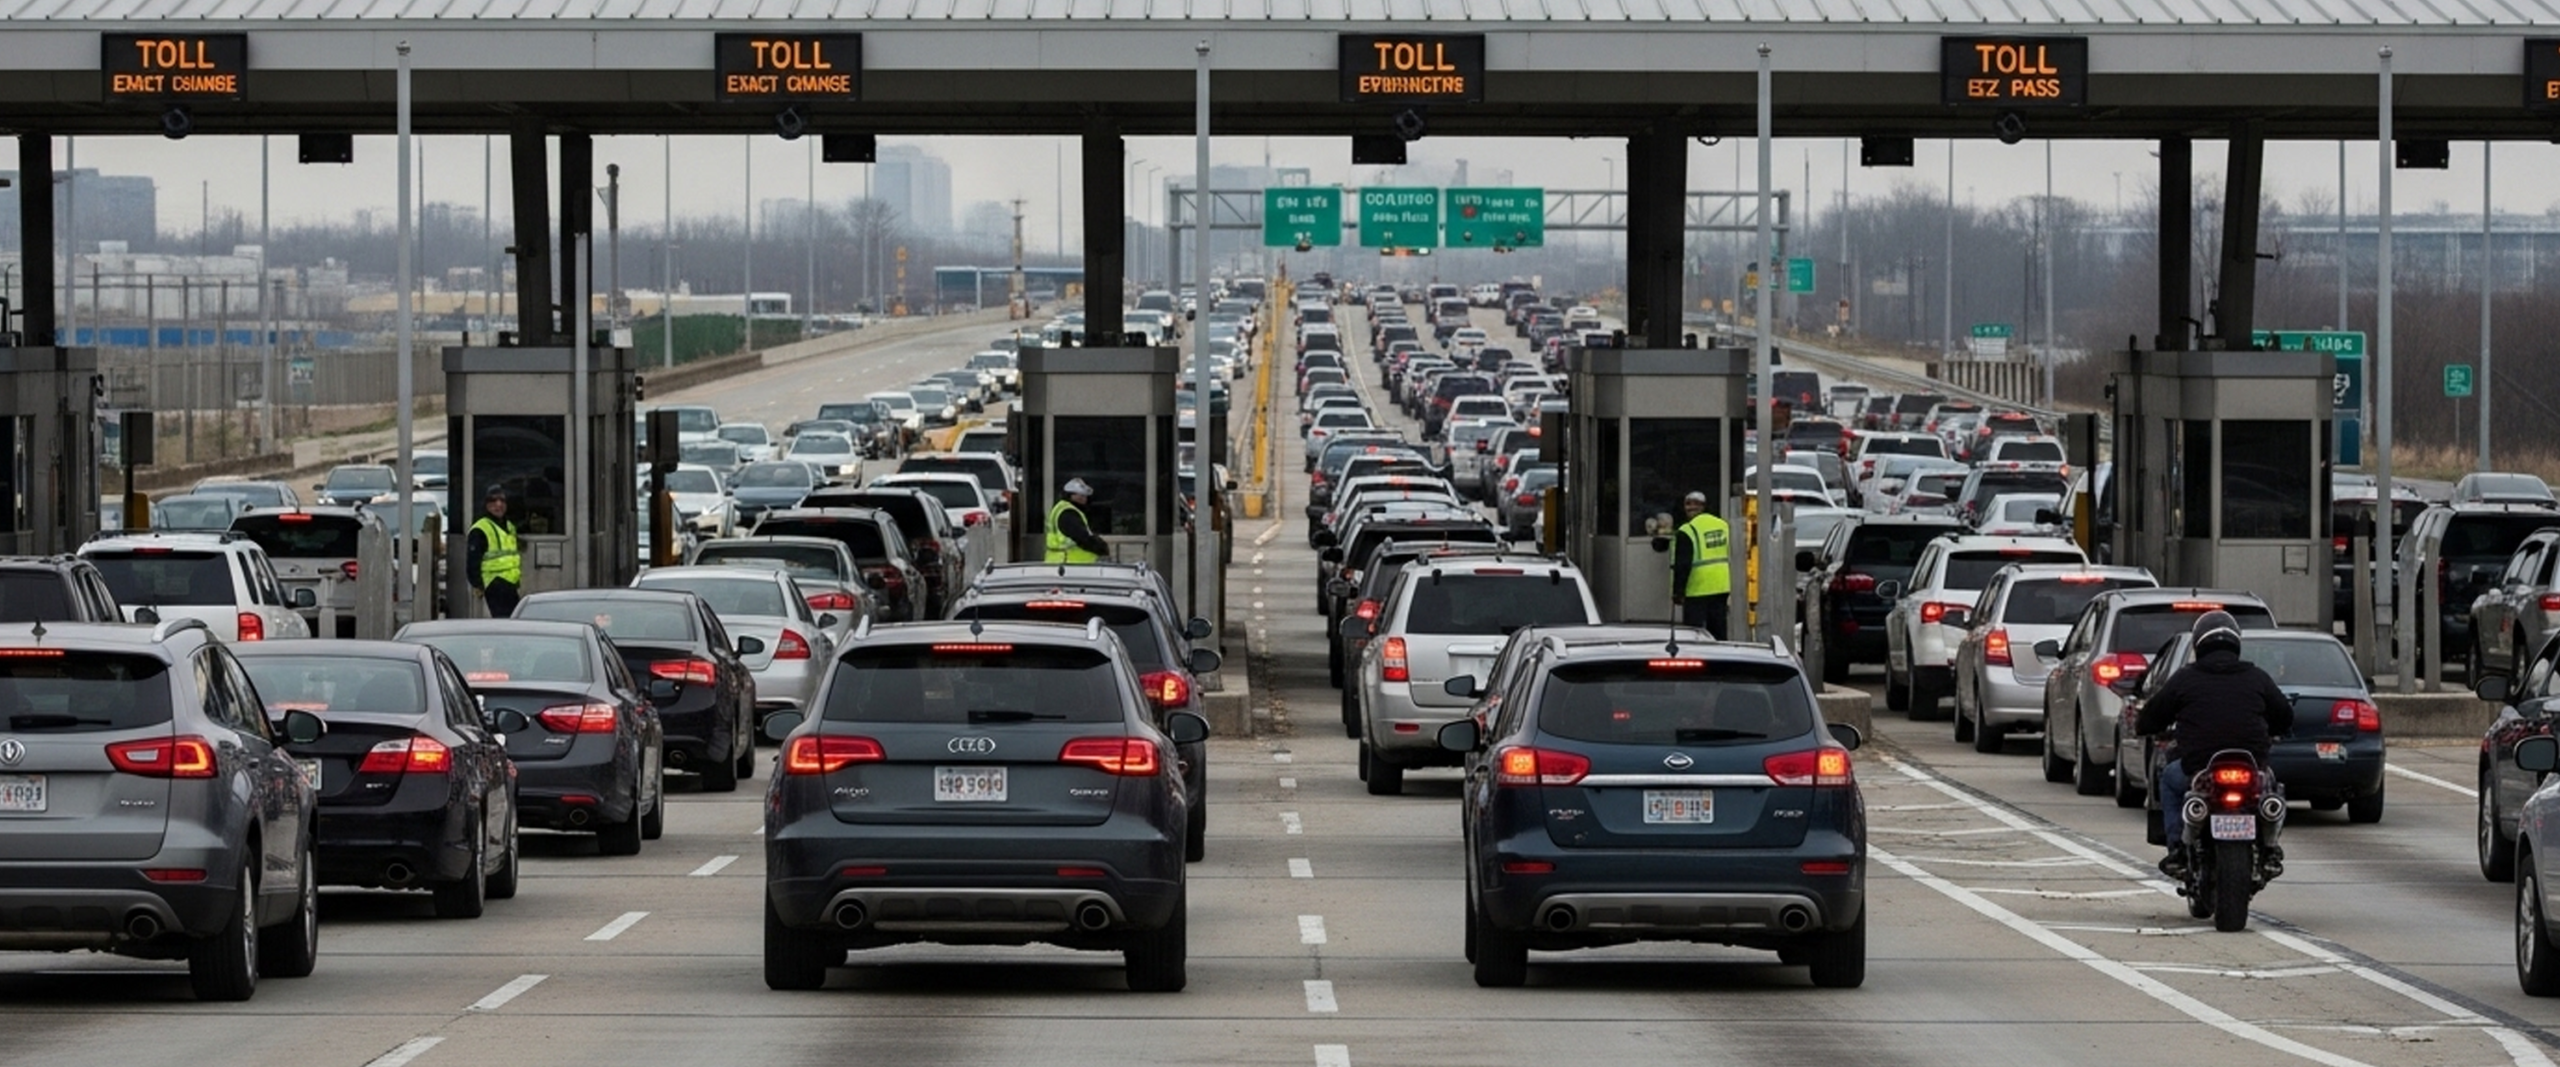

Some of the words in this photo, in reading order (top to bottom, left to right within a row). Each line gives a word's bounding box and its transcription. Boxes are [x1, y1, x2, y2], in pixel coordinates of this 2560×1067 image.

[137, 41, 214, 69] TOLL
[752, 42, 831, 70] TOLL
[1375, 43, 1455, 71] TOLL
[1976, 45, 2057, 74] TOLL
[727, 75, 778, 92] EXACT
[2012, 79, 2060, 97] PASS
